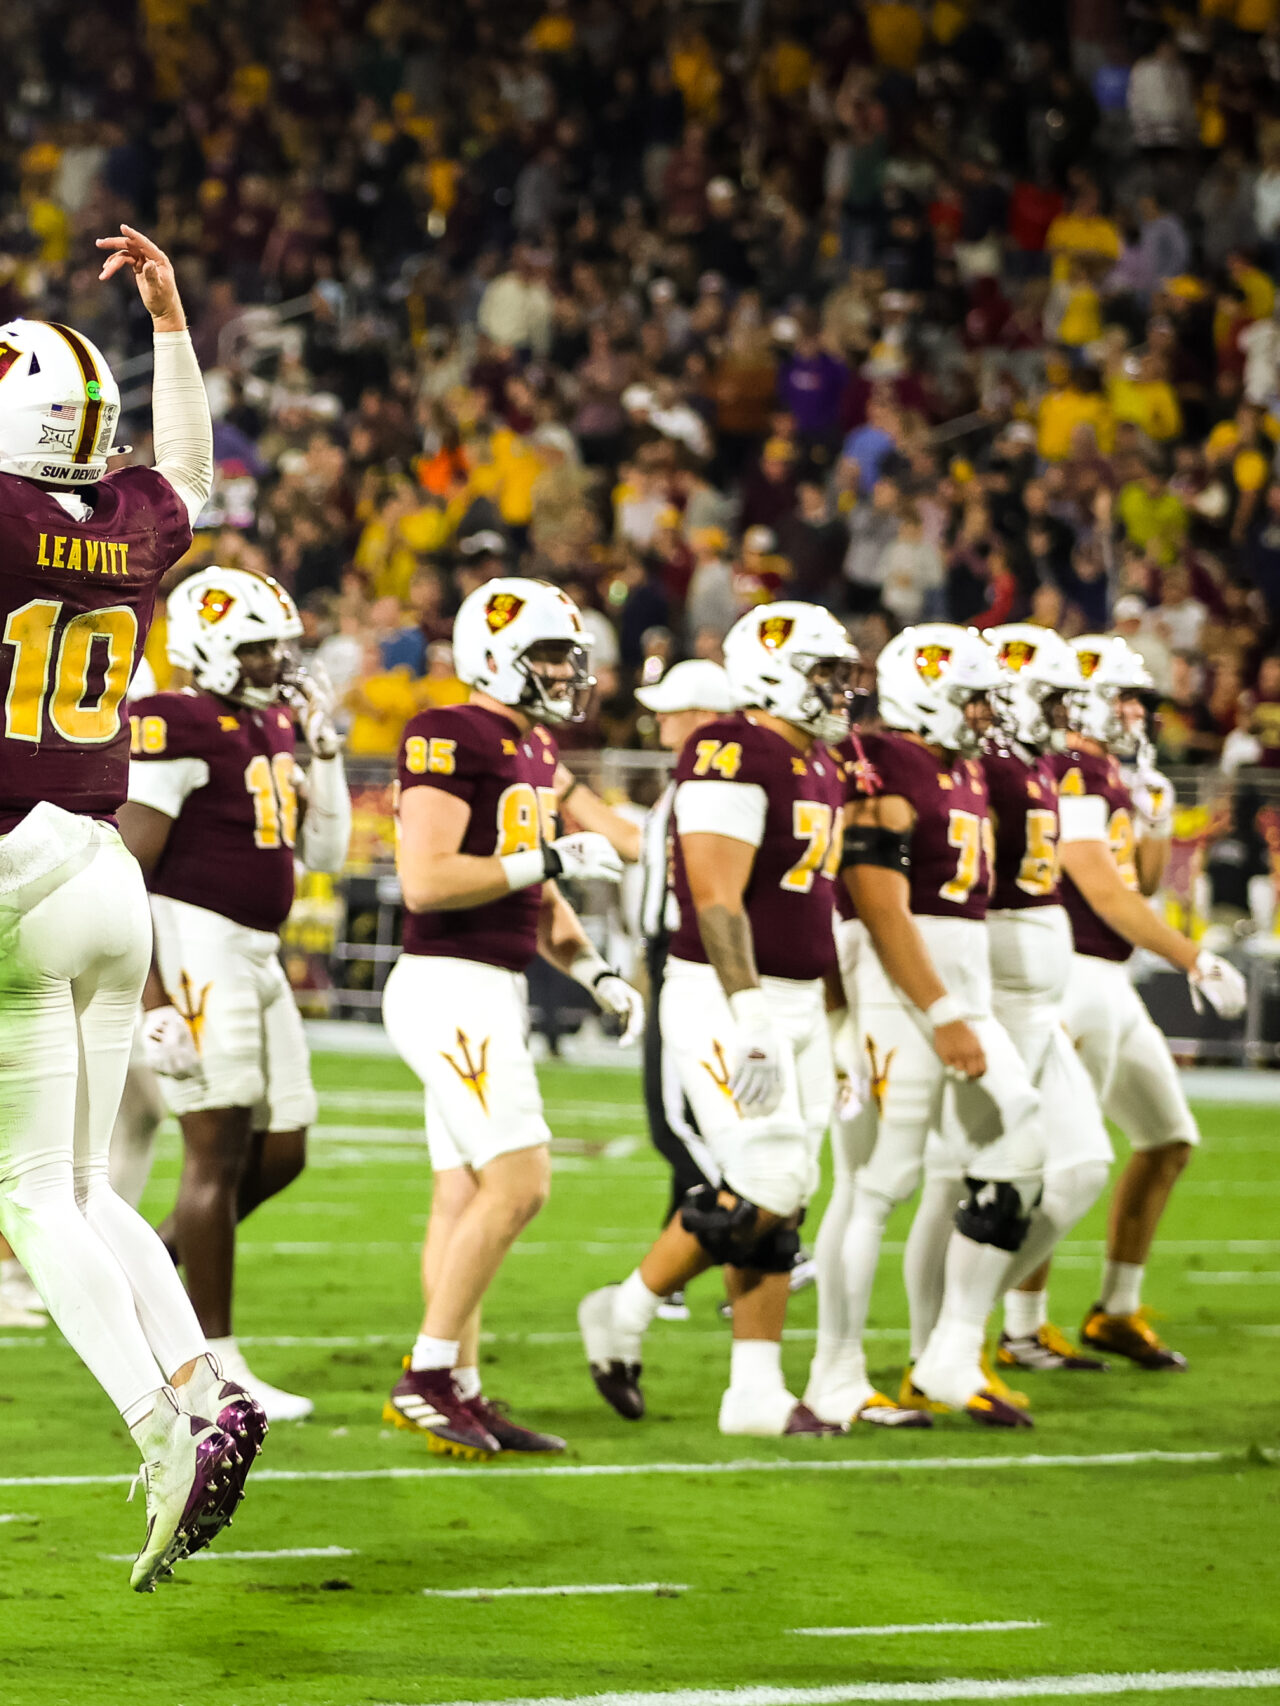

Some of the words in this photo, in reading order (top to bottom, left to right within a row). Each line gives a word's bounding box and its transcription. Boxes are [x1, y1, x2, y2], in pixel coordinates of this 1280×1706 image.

[40, 465, 71, 480] SUN
[71, 468, 101, 480] DEVILS
[37, 533, 129, 576] LEAVITT
[2, 598, 138, 744] 10
[130, 715, 167, 754] 18
[405, 736, 457, 775] 85
[693, 739, 742, 779] 74
[938, 808, 996, 904] 7
